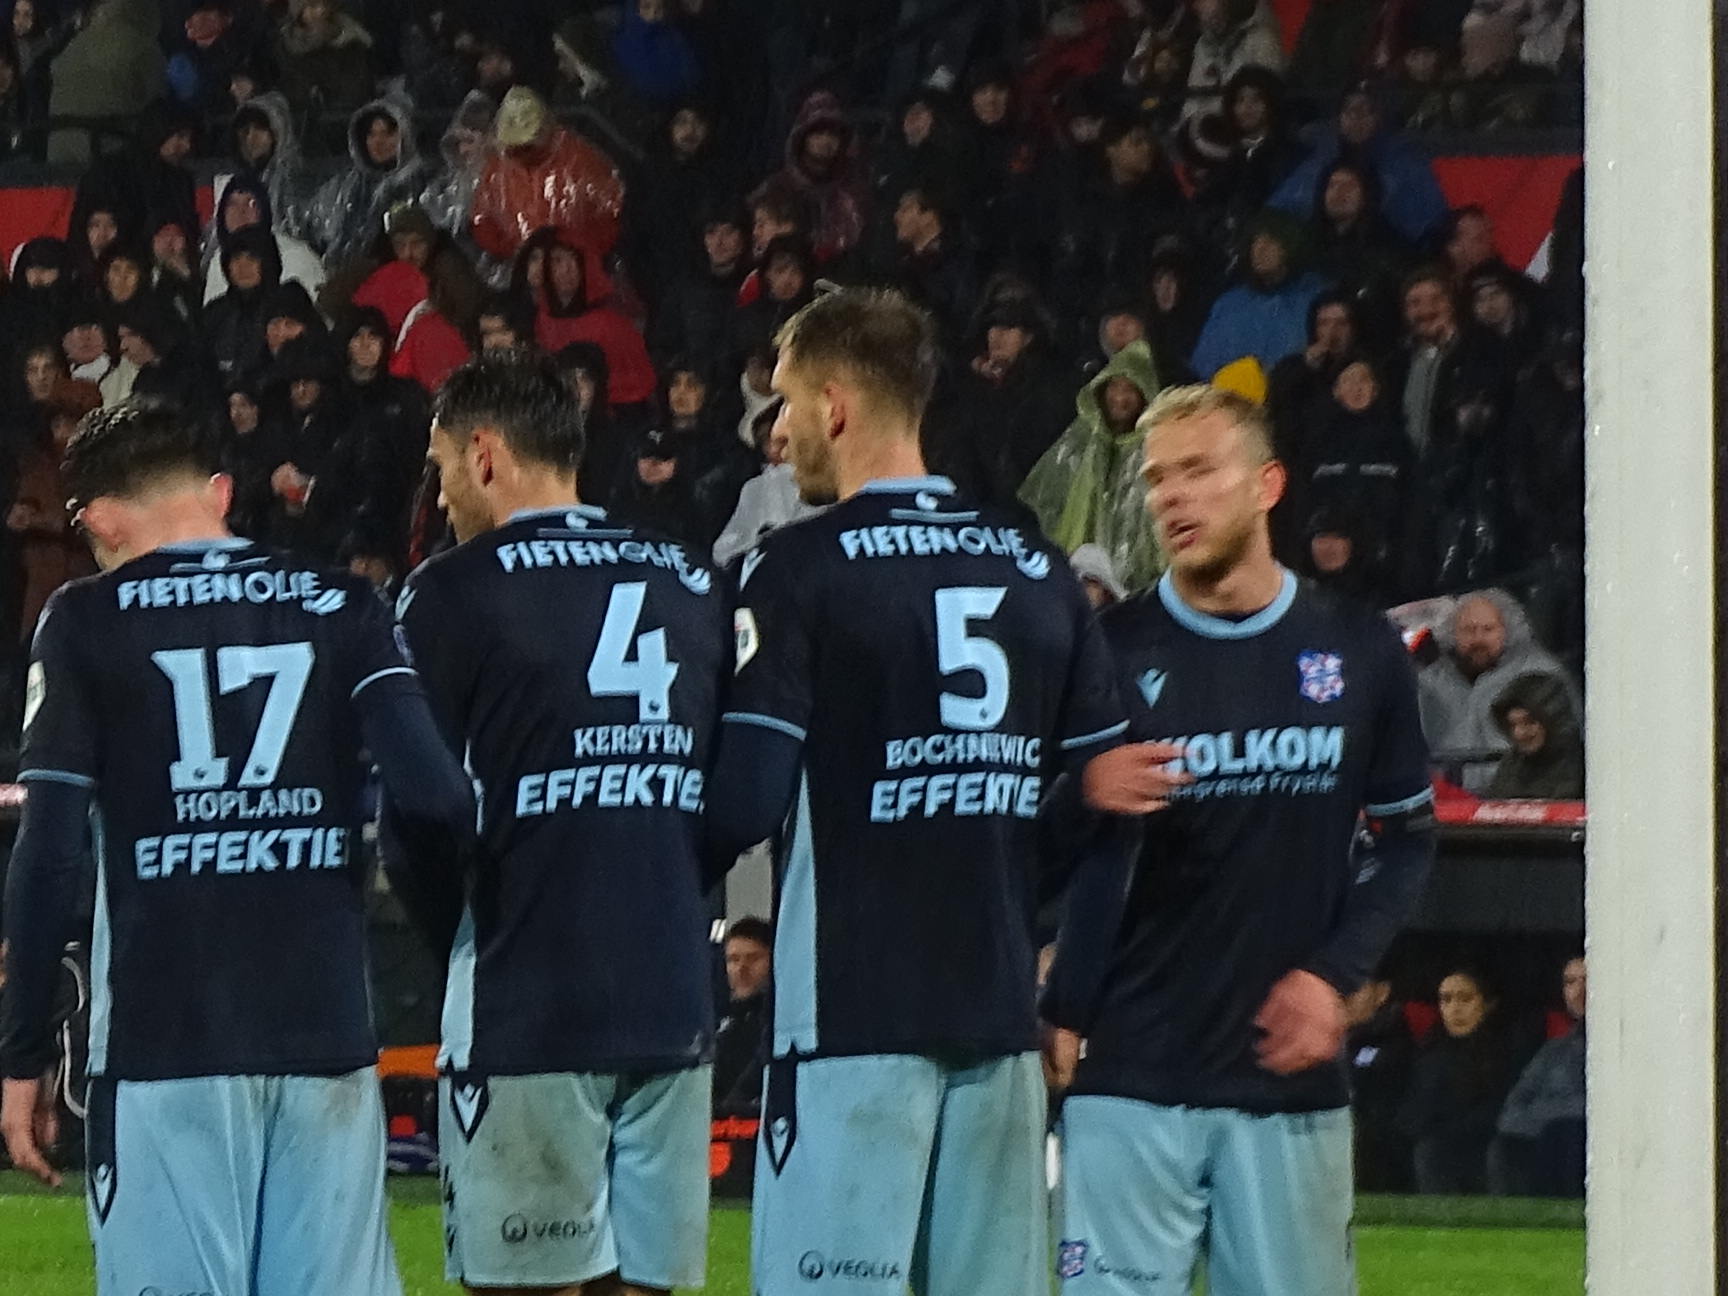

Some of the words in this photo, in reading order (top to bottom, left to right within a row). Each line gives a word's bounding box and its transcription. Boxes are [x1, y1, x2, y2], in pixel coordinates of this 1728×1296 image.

[117, 569, 322, 611] FIETENOLIE
[586, 580, 680, 723] 4
[934, 585, 1011, 732] 5
[151, 640, 316, 792] 17
[573, 723, 695, 759] KERSTEN
[174, 787, 324, 823] HOPLAND
